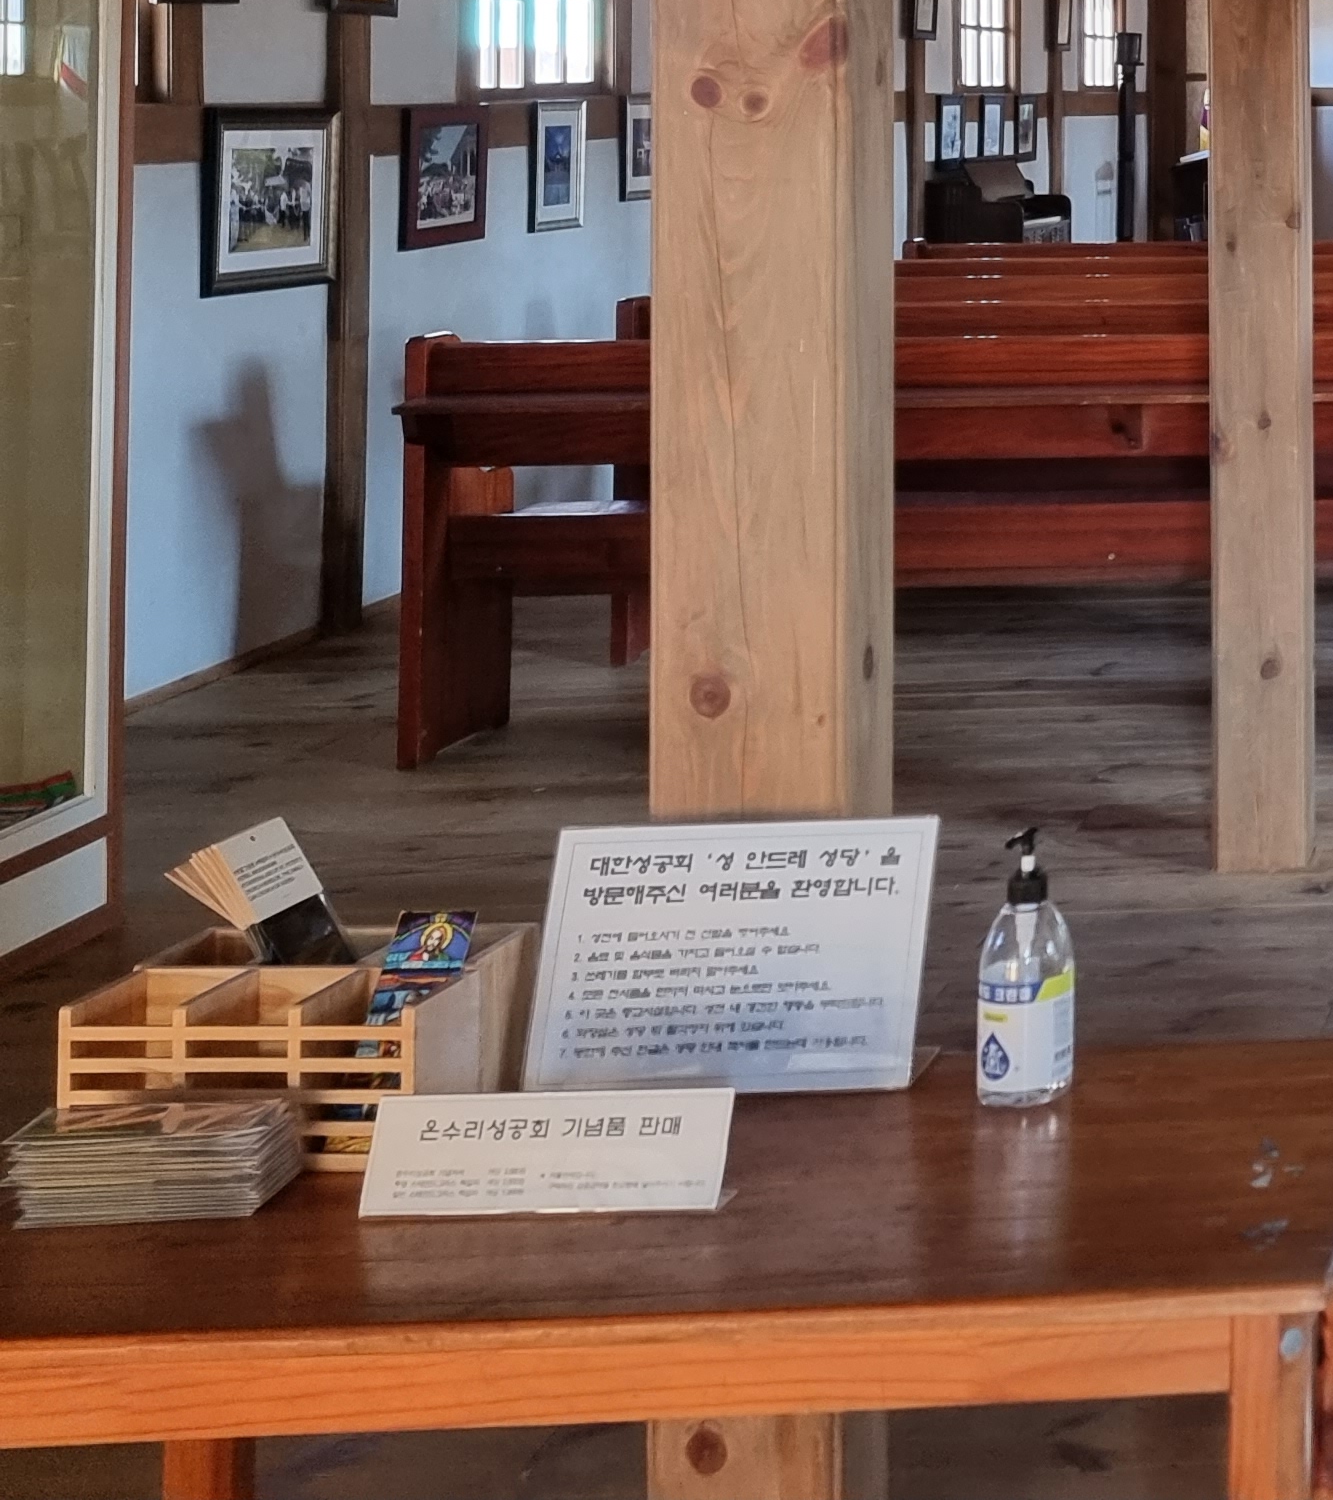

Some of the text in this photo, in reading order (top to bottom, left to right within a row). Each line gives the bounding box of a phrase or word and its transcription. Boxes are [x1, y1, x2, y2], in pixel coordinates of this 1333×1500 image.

[590, 853, 693, 877] 대한성공회
[745, 849, 807, 870] 안드레
[583, 876, 899, 906] 방문해주신 여러분을 환영합니다.
[419, 1115, 683, 1141] 온수리성공회 기념품 판매
